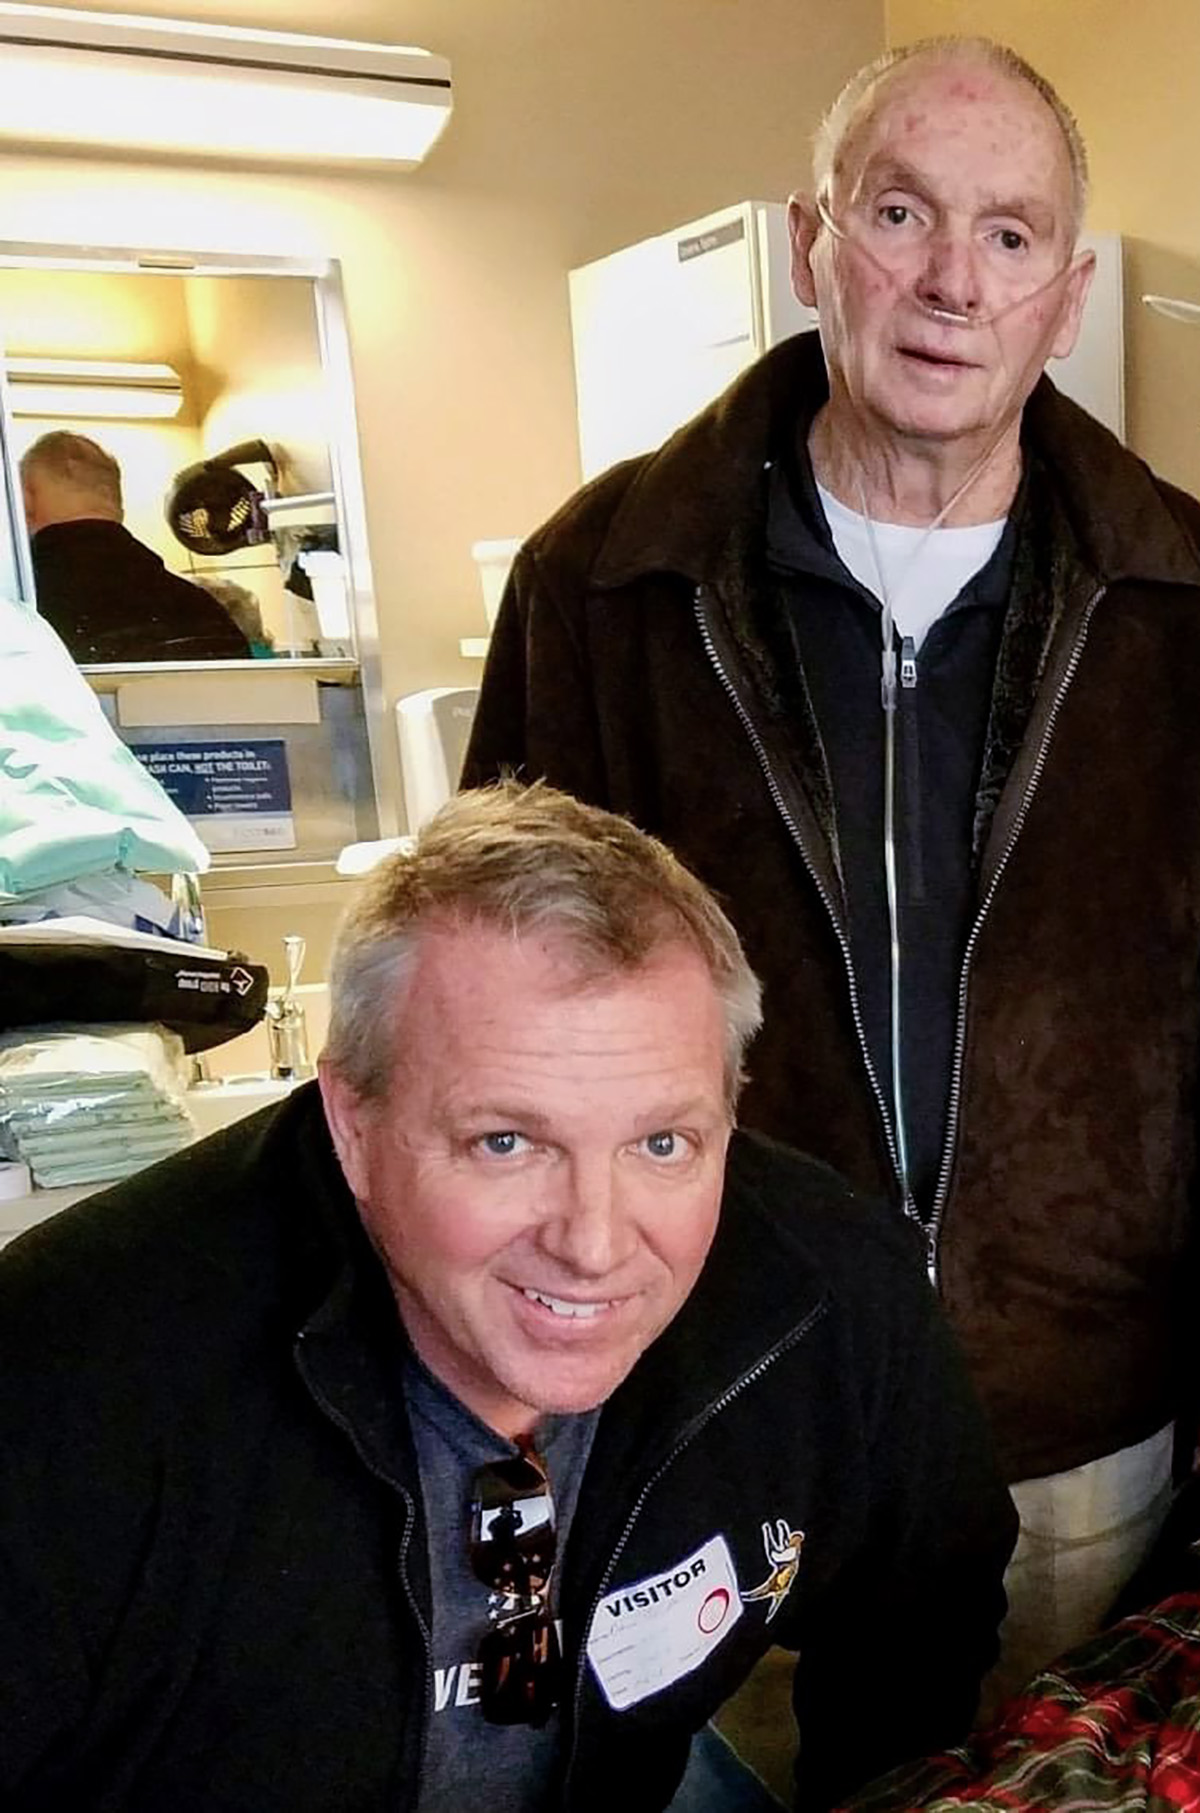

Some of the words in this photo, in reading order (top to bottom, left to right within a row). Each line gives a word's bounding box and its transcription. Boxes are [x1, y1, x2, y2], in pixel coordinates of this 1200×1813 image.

[150, 751, 174, 762] place
[203, 750, 243, 761] products
[149, 763, 167, 774] ASH
[215, 762, 234, 772] THE
[607, 1558, 707, 1618] VISITOR
